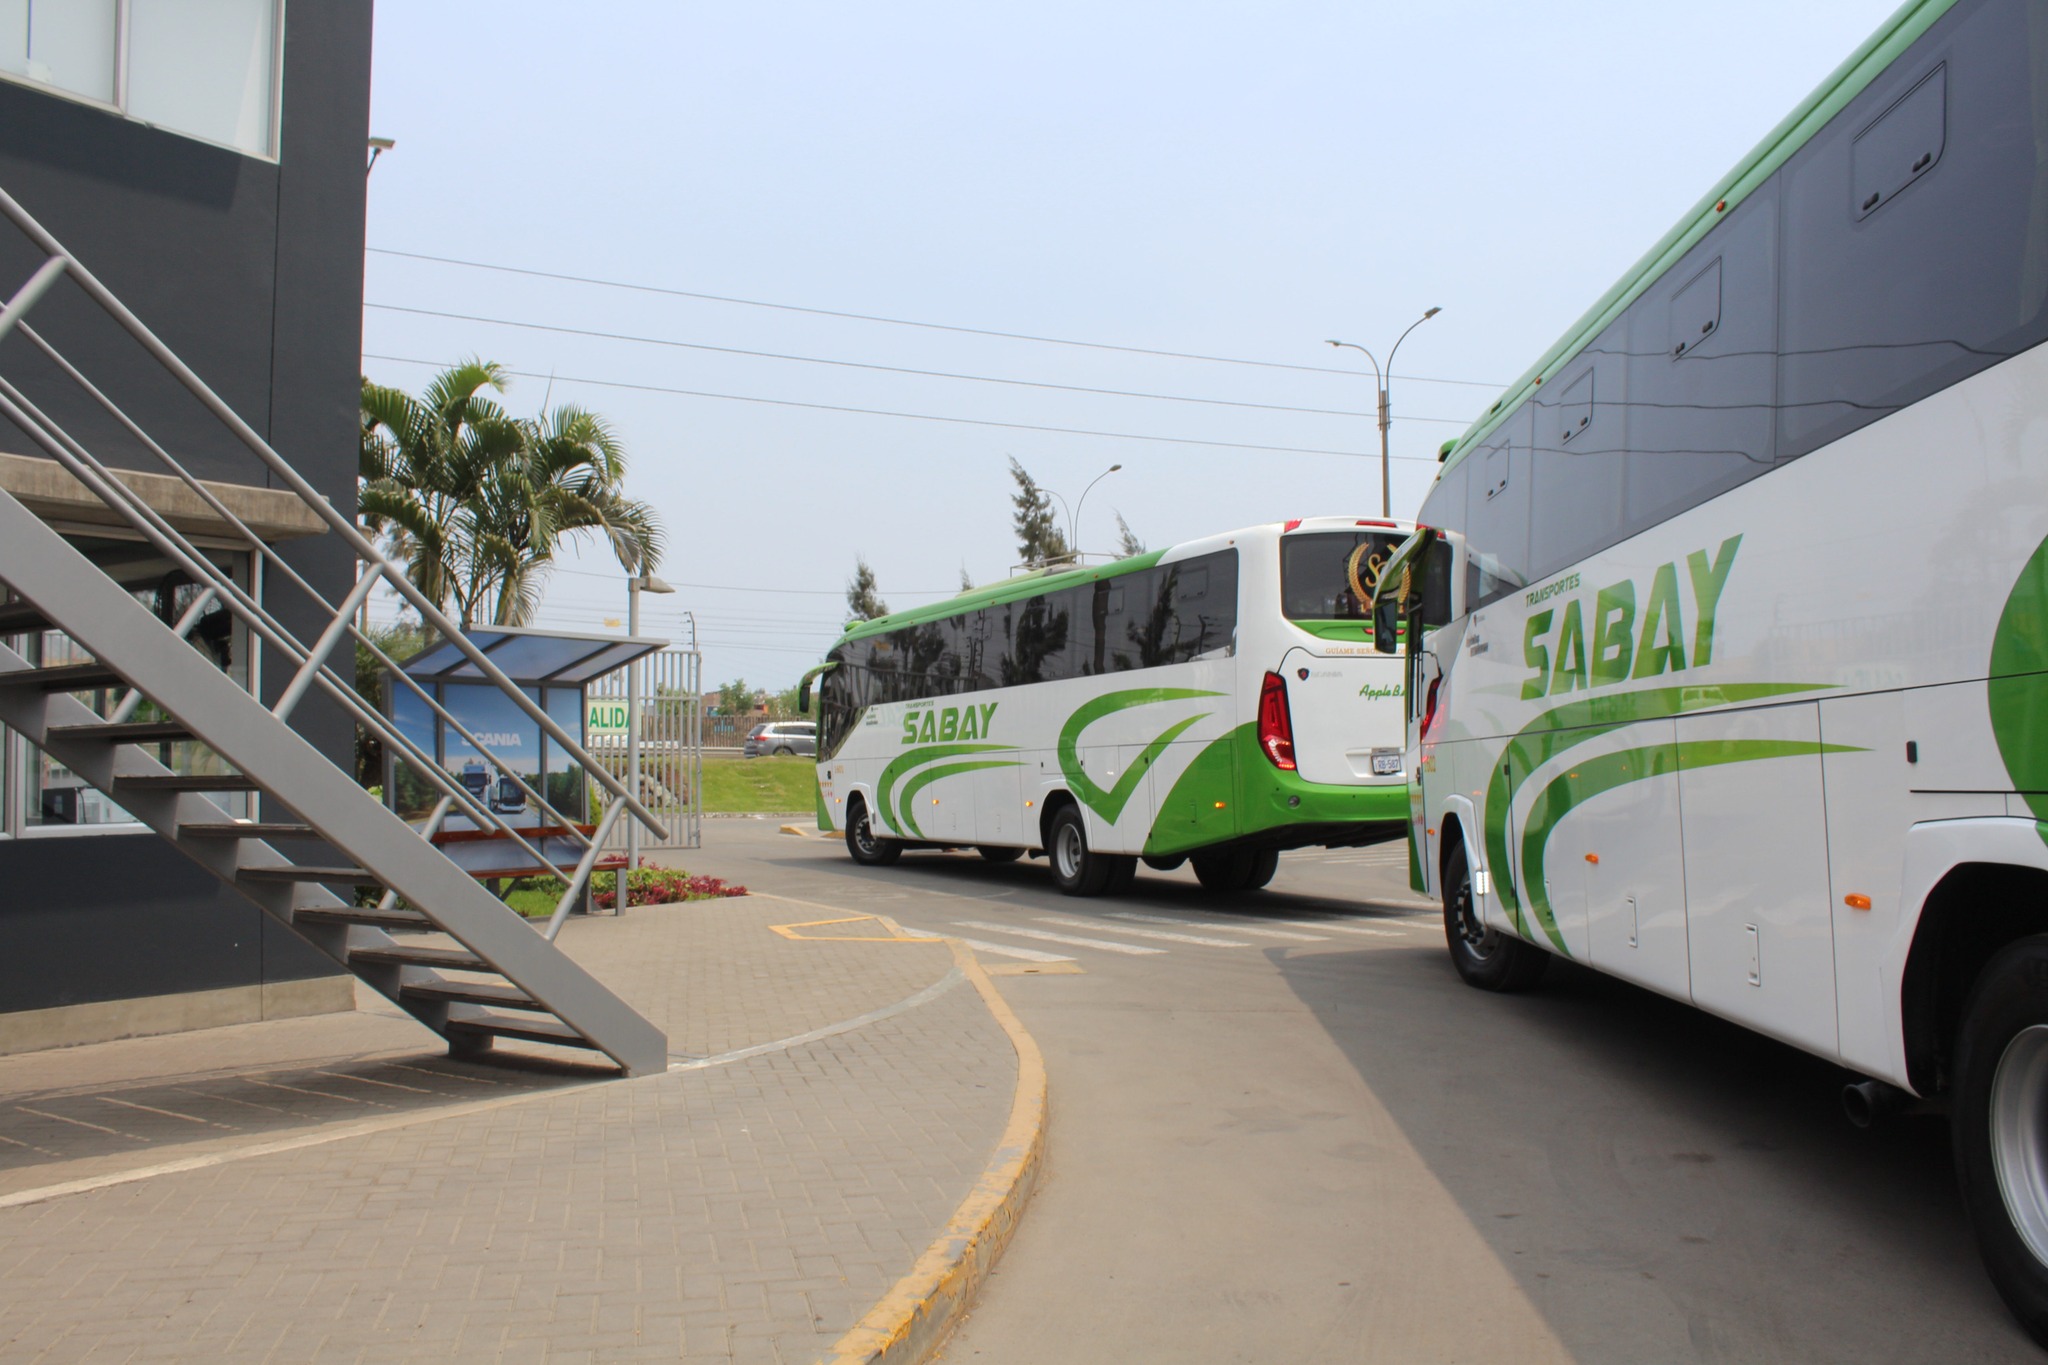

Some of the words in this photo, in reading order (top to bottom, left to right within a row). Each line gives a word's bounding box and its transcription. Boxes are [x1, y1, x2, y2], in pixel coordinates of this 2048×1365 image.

[1526, 572, 1581, 608] TRANSPORTES
[1520, 533, 1744, 701] SABAY
[589, 707, 629, 728] ALID
[901, 702, 999, 744] SABAY
